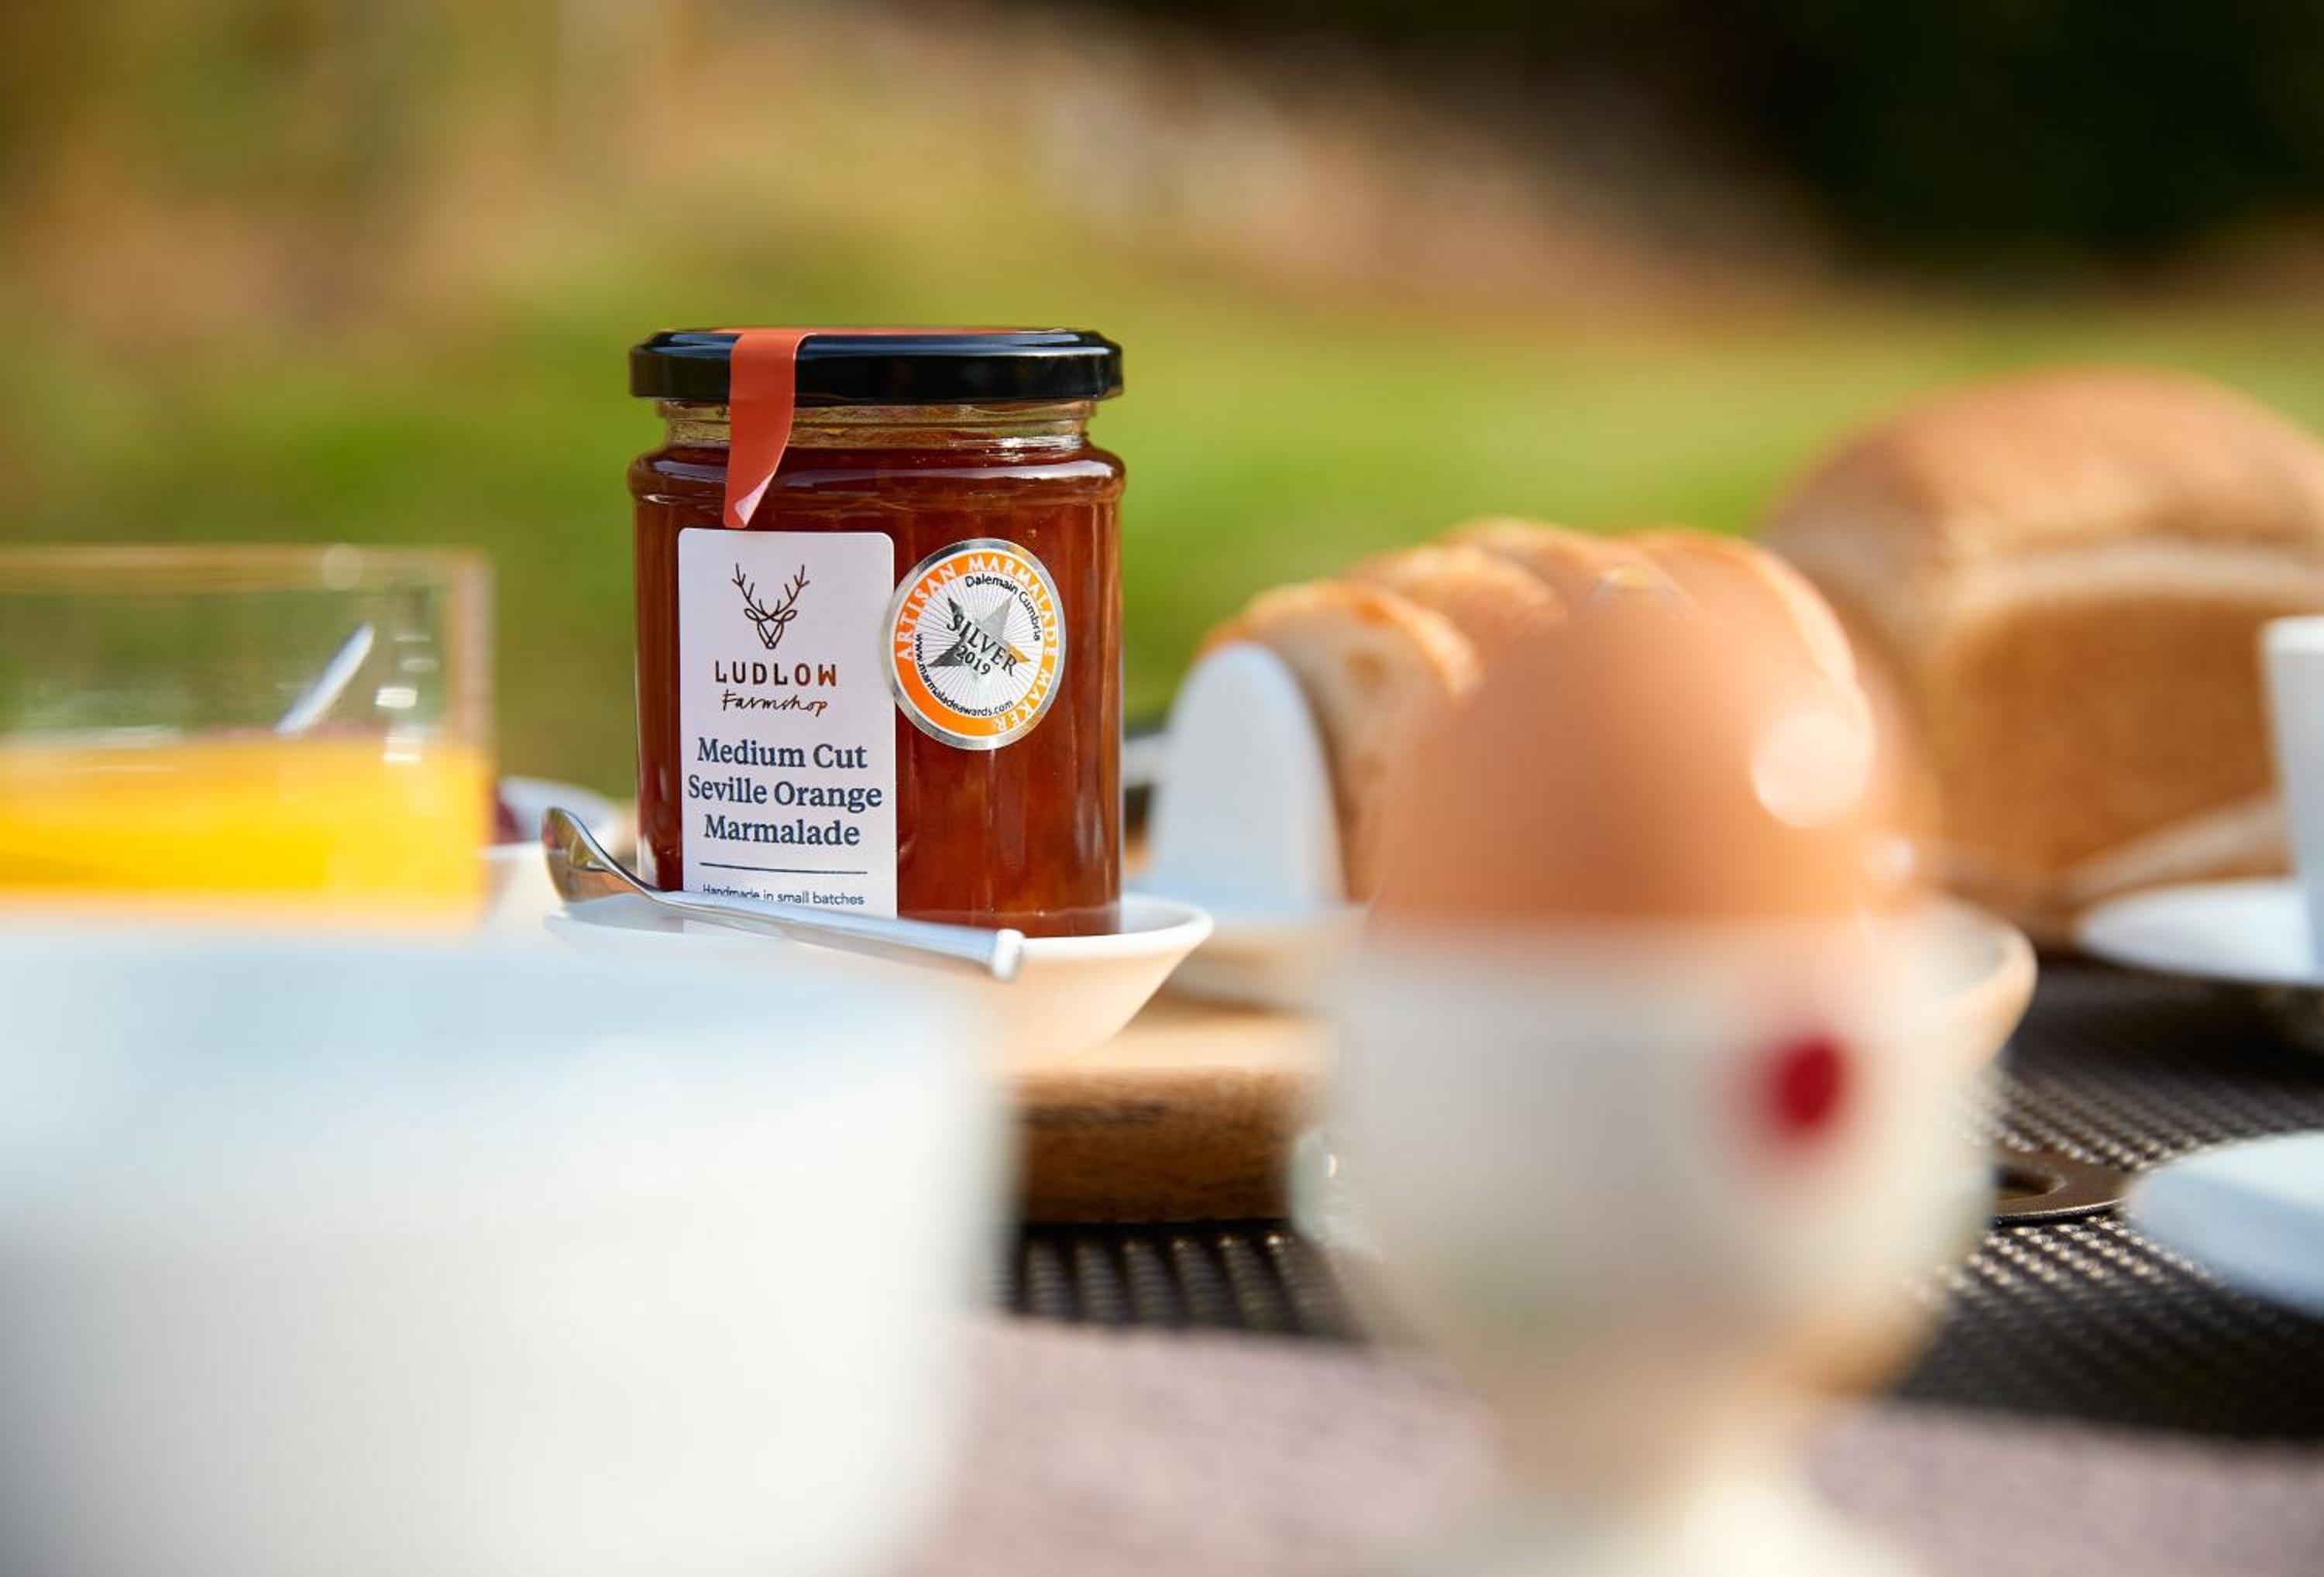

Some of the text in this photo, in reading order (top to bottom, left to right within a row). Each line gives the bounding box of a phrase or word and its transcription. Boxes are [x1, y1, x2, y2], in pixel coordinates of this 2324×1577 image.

[964, 574, 1041, 641] Dalemain Cumbria
[896, 556, 1059, 732] ARTISAN MARMALADE MAKER
[946, 615, 1018, 676] SILVER
[956, 645, 991, 675] 2019
[715, 661, 837, 686] LUDLOW
[915, 633, 1014, 716] www.marmaladeawards.com
[722, 689, 828, 717] Farmshop
[697, 737, 868, 769] Medium Cut
[688, 775, 882, 813] Seville Orange
[703, 814, 861, 847] Marmalade
[702, 884, 865, 905] Handmade in small batches
